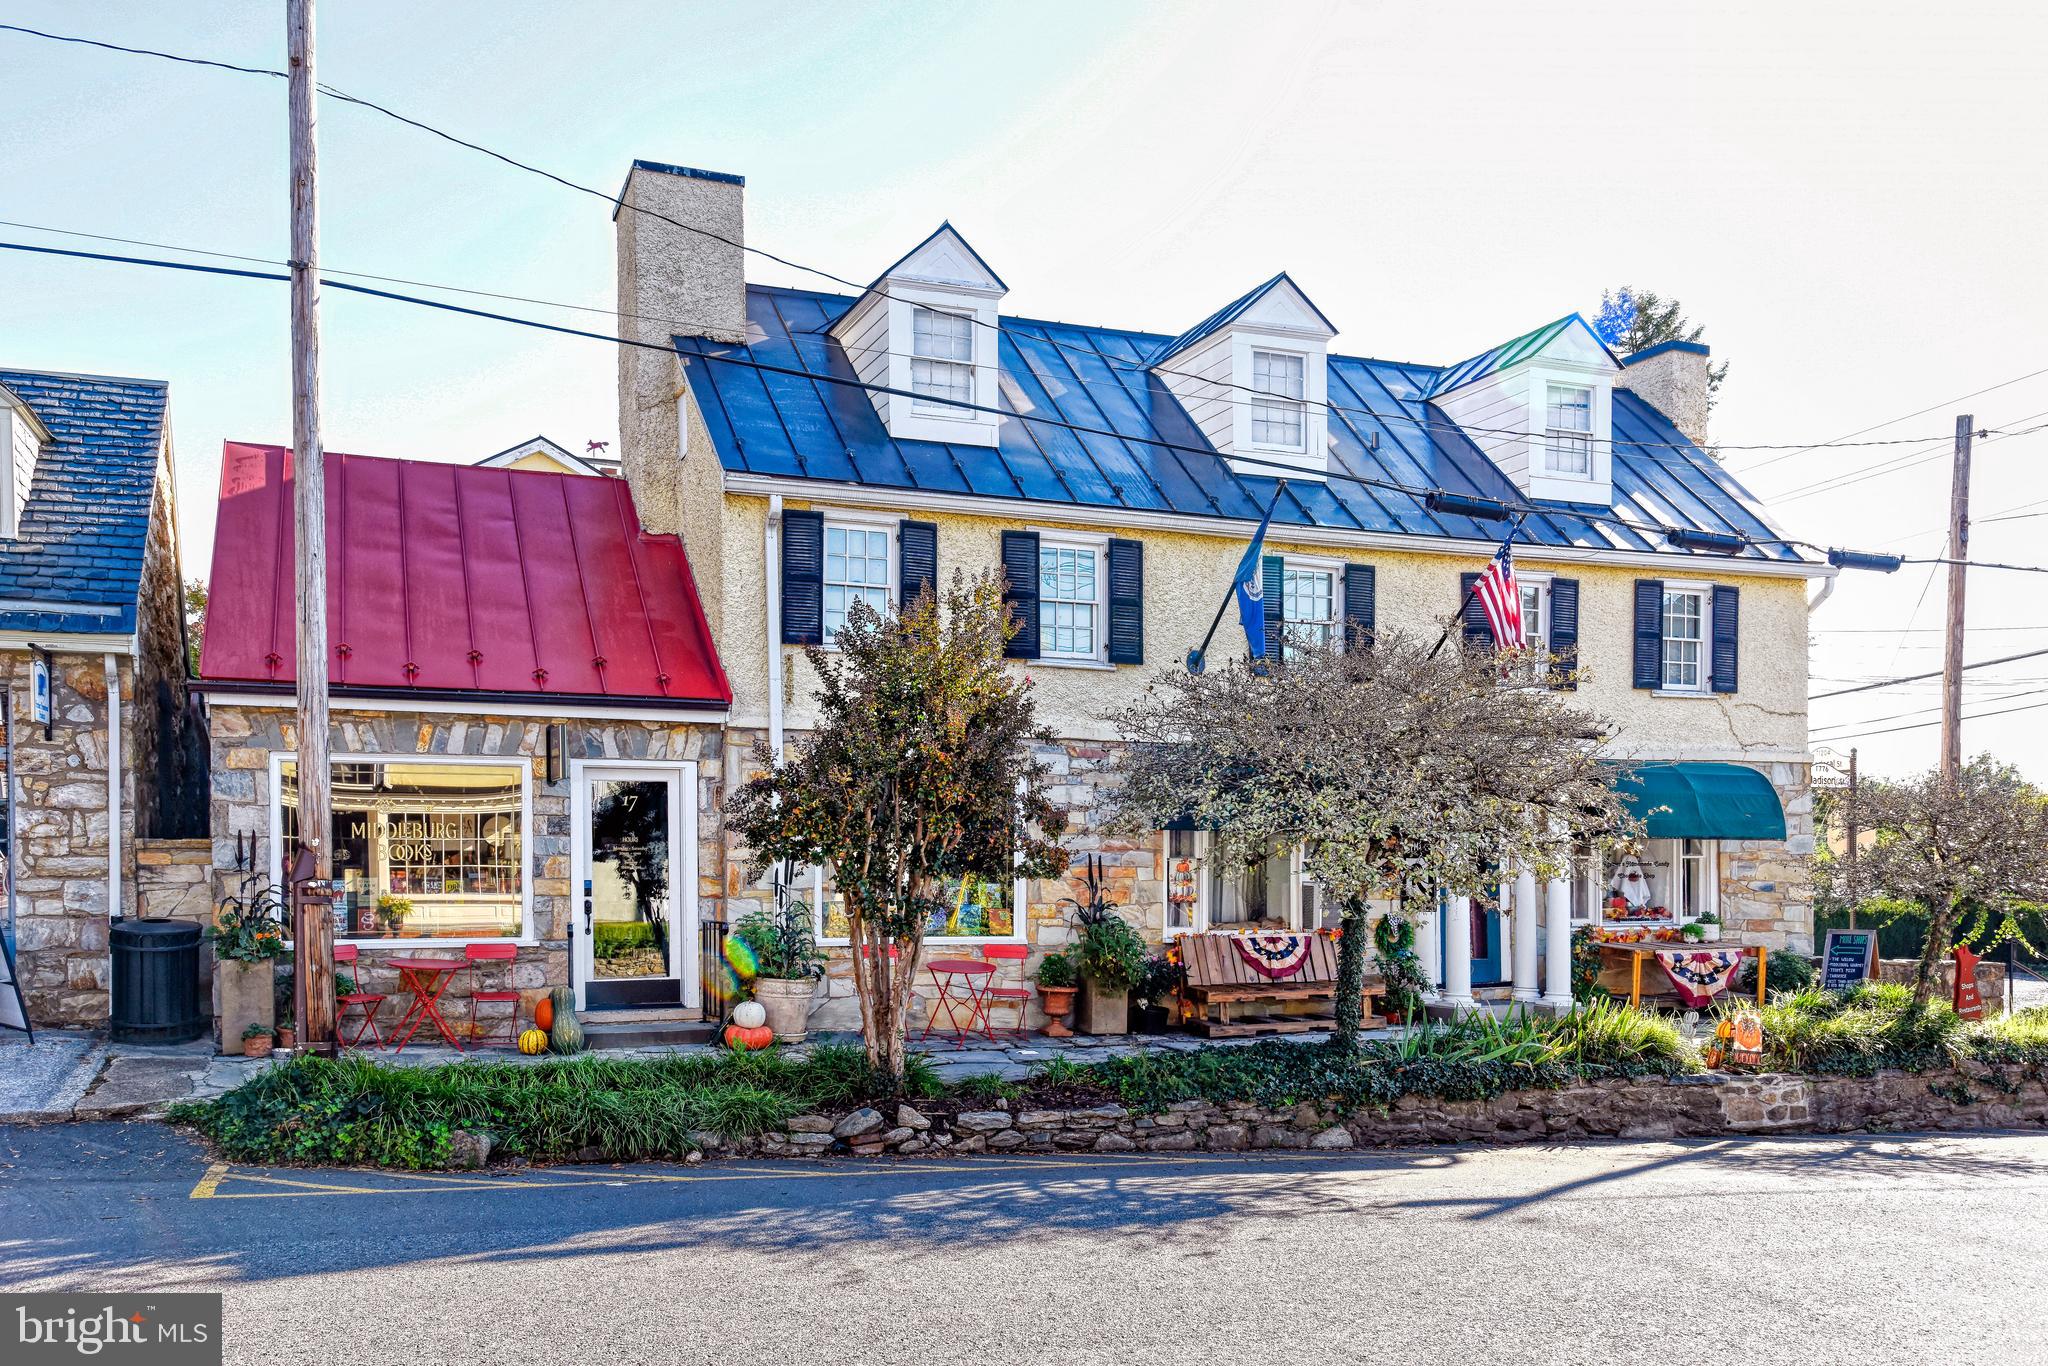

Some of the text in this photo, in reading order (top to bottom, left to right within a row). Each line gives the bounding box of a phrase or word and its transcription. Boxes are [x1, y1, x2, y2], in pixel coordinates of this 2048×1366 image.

[621, 795, 639, 813] 17
[351, 822, 457, 839] MIDDLEBURG
[377, 843, 433, 861] BOOKS
